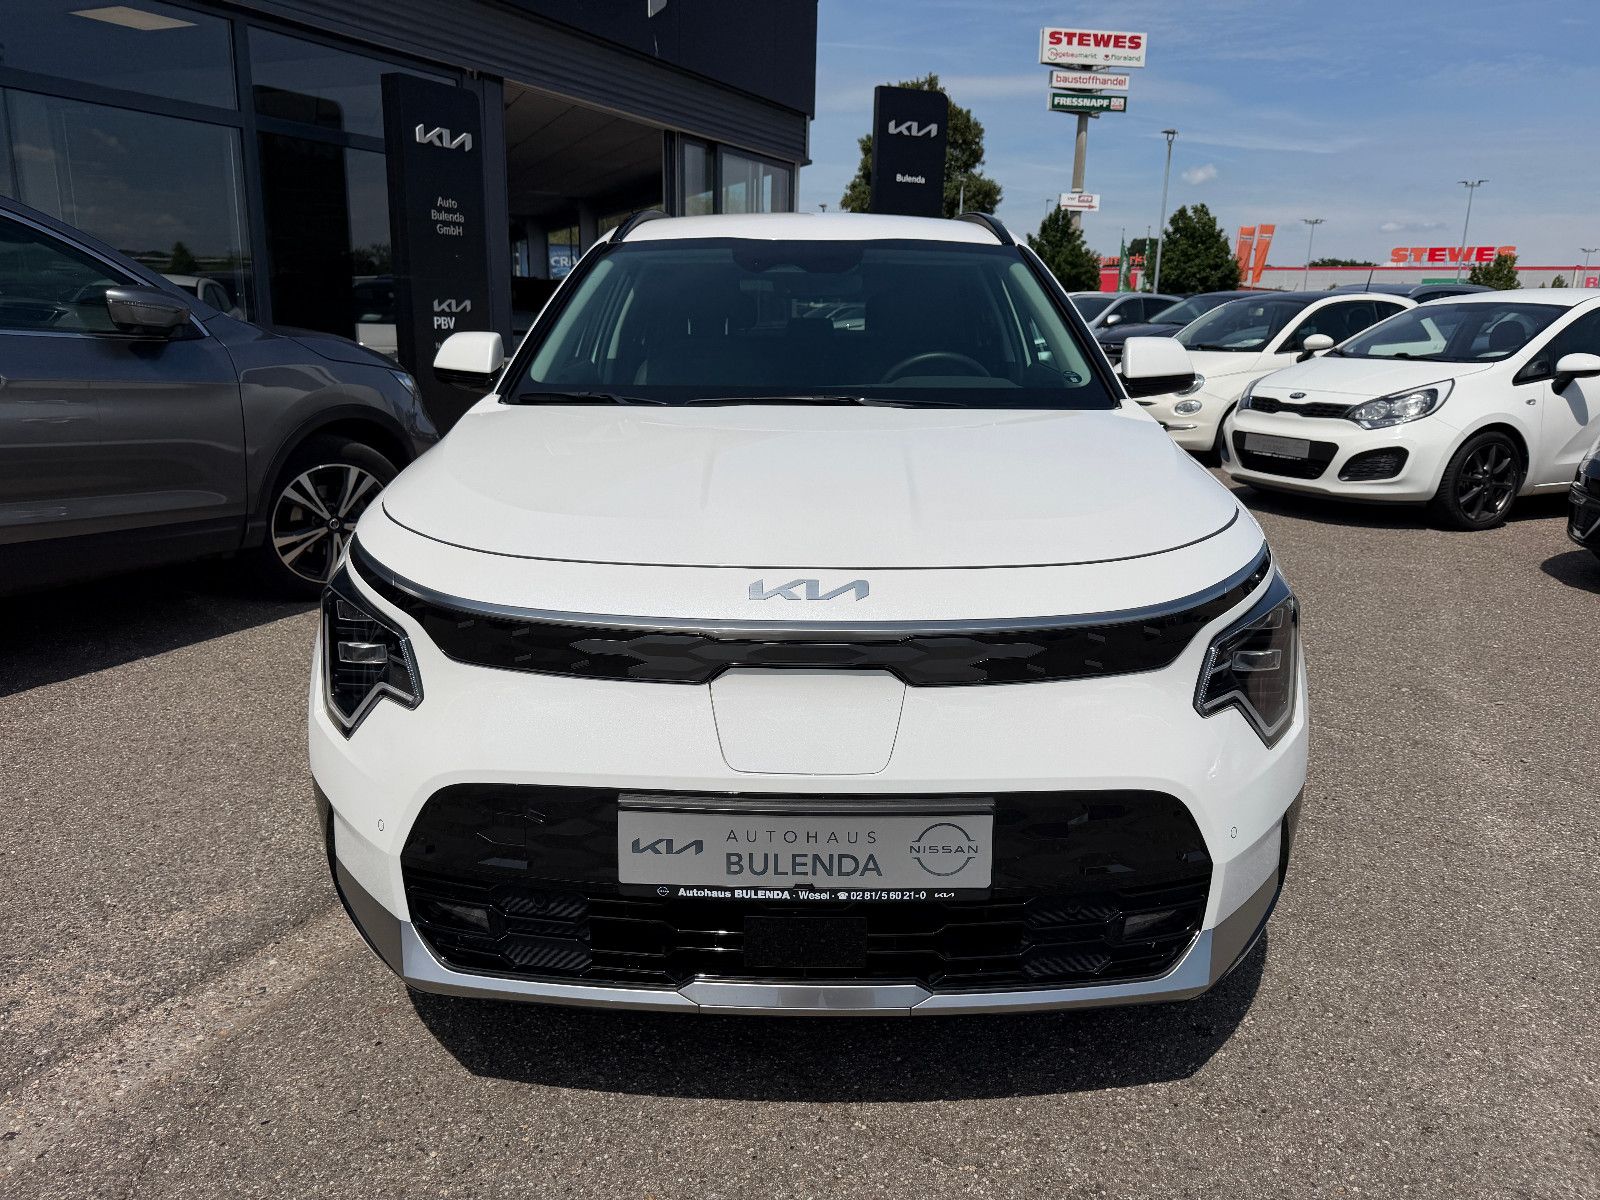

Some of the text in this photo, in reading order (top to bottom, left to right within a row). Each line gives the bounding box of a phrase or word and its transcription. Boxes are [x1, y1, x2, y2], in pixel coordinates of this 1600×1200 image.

[1048, 31, 1142, 50] STEWES
[1055, 74, 1127, 87] baustoffhandel
[1054, 96, 1110, 108] FRESSNAPF
[888, 119, 938, 138] KIA
[415, 123, 473, 152] KIA
[895, 173, 926, 184] Bulenda
[437, 196, 458, 209] Auto
[431, 209, 465, 223] Bulenda
[436, 224, 463, 237] GmbH
[433, 299, 472, 313] KIA
[433, 316, 456, 330] PBV
[748, 578, 870, 601] KIA
[726, 829, 877, 844] AUTOHAUS
[631, 837, 704, 856] KIA
[909, 845, 979, 855] NISSAN
[725, 852, 883, 877] BULENDA
[678, 887, 732, 899] Autohaus
[734, 889, 791, 900] BULENDA
[798, 890, 830, 901] Wesel
